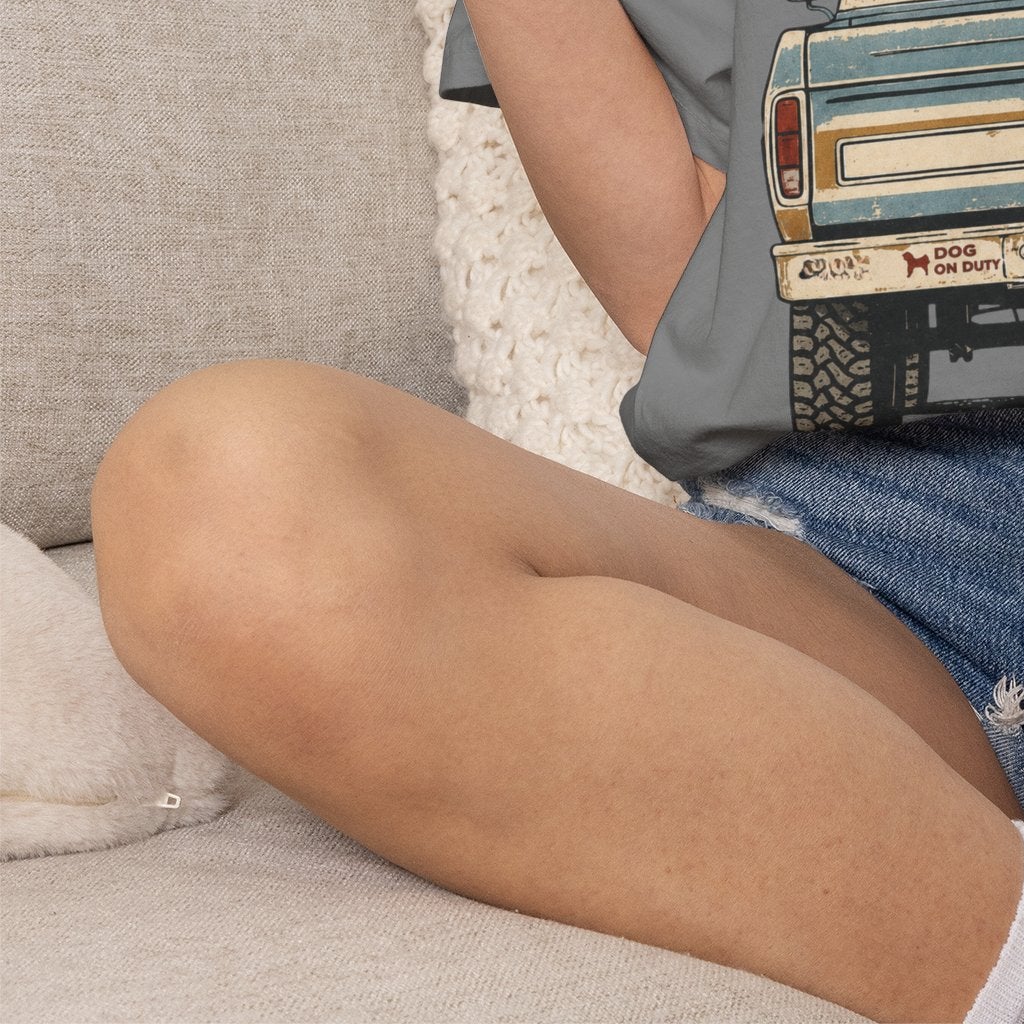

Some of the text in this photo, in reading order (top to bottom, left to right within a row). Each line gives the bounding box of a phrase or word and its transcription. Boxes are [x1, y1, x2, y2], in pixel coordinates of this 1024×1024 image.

[934, 244, 977, 260] DOG
[934, 258, 1001, 276] ON DUTY
